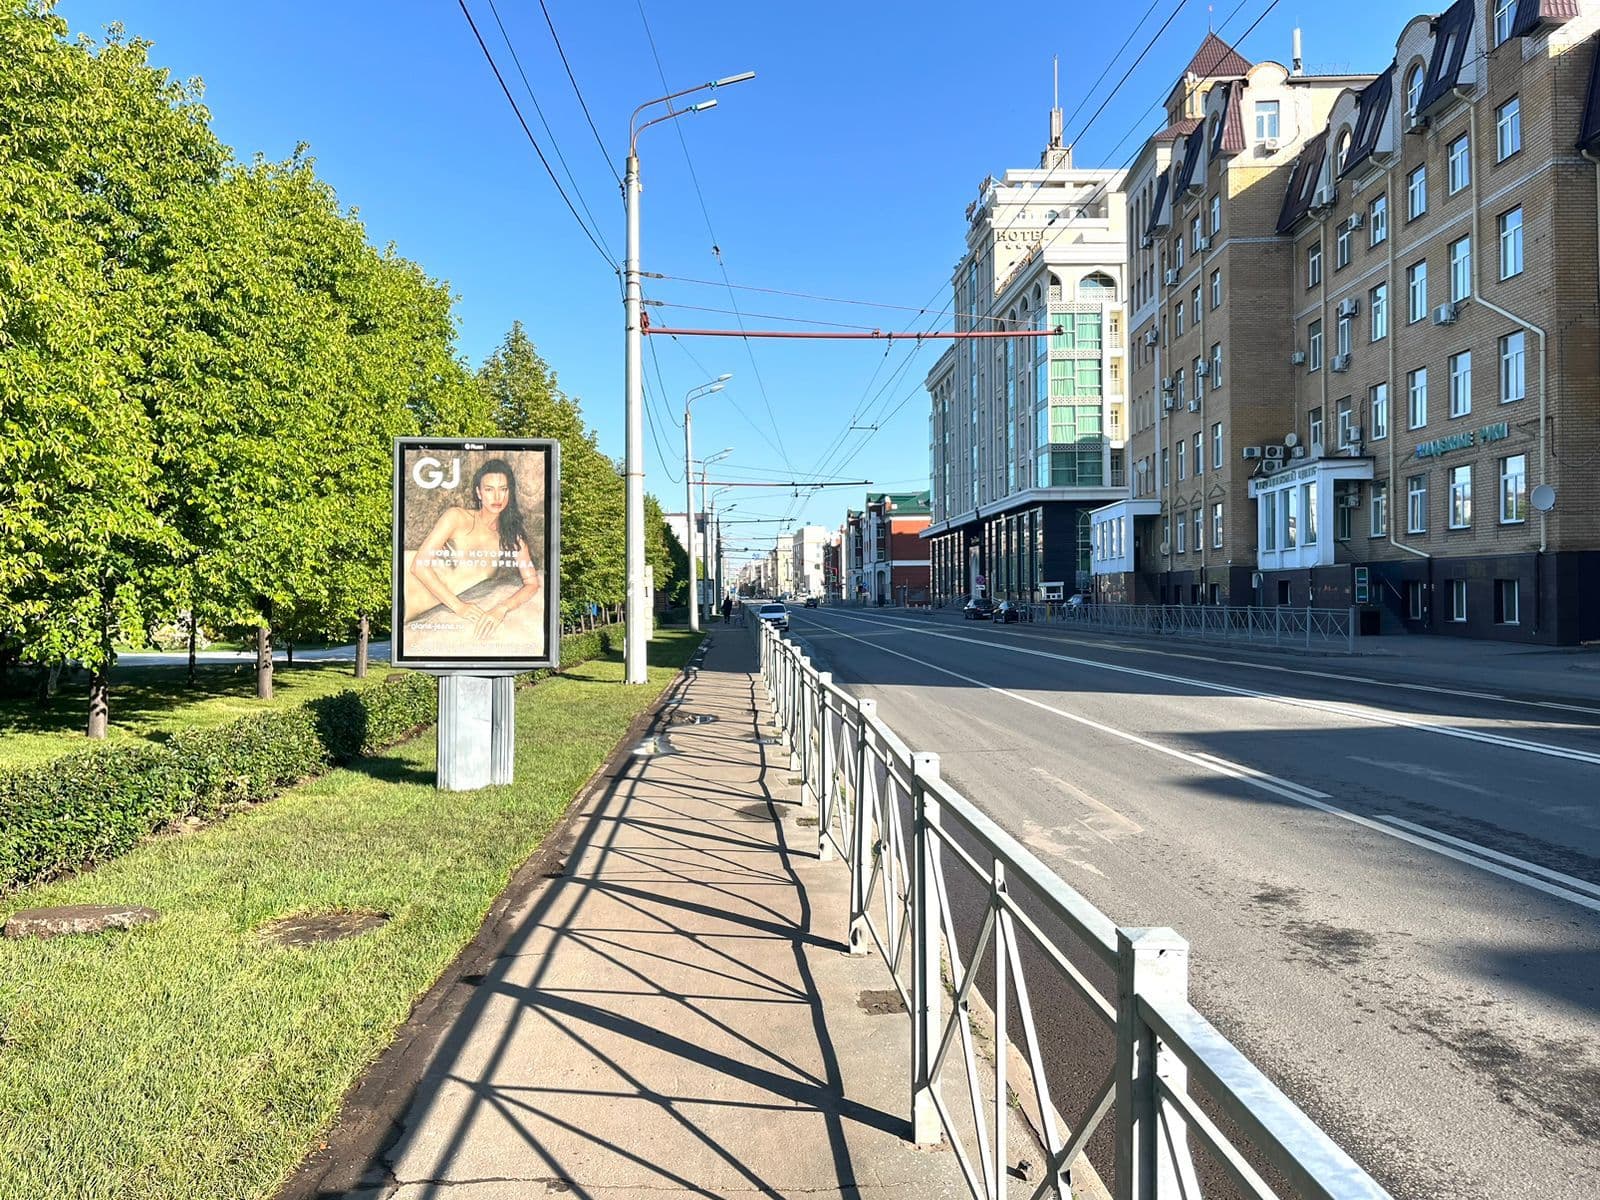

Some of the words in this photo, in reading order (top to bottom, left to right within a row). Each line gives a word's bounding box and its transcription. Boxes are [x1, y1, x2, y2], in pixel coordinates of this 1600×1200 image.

[996, 230, 1049, 242] HOTEL
[412, 456, 461, 490] GJ
[429, 550, 464, 558] НОВАЯ
[469, 550, 519, 558] ИСТОРИЯ
[491, 560, 535, 569] БРЕНДА
